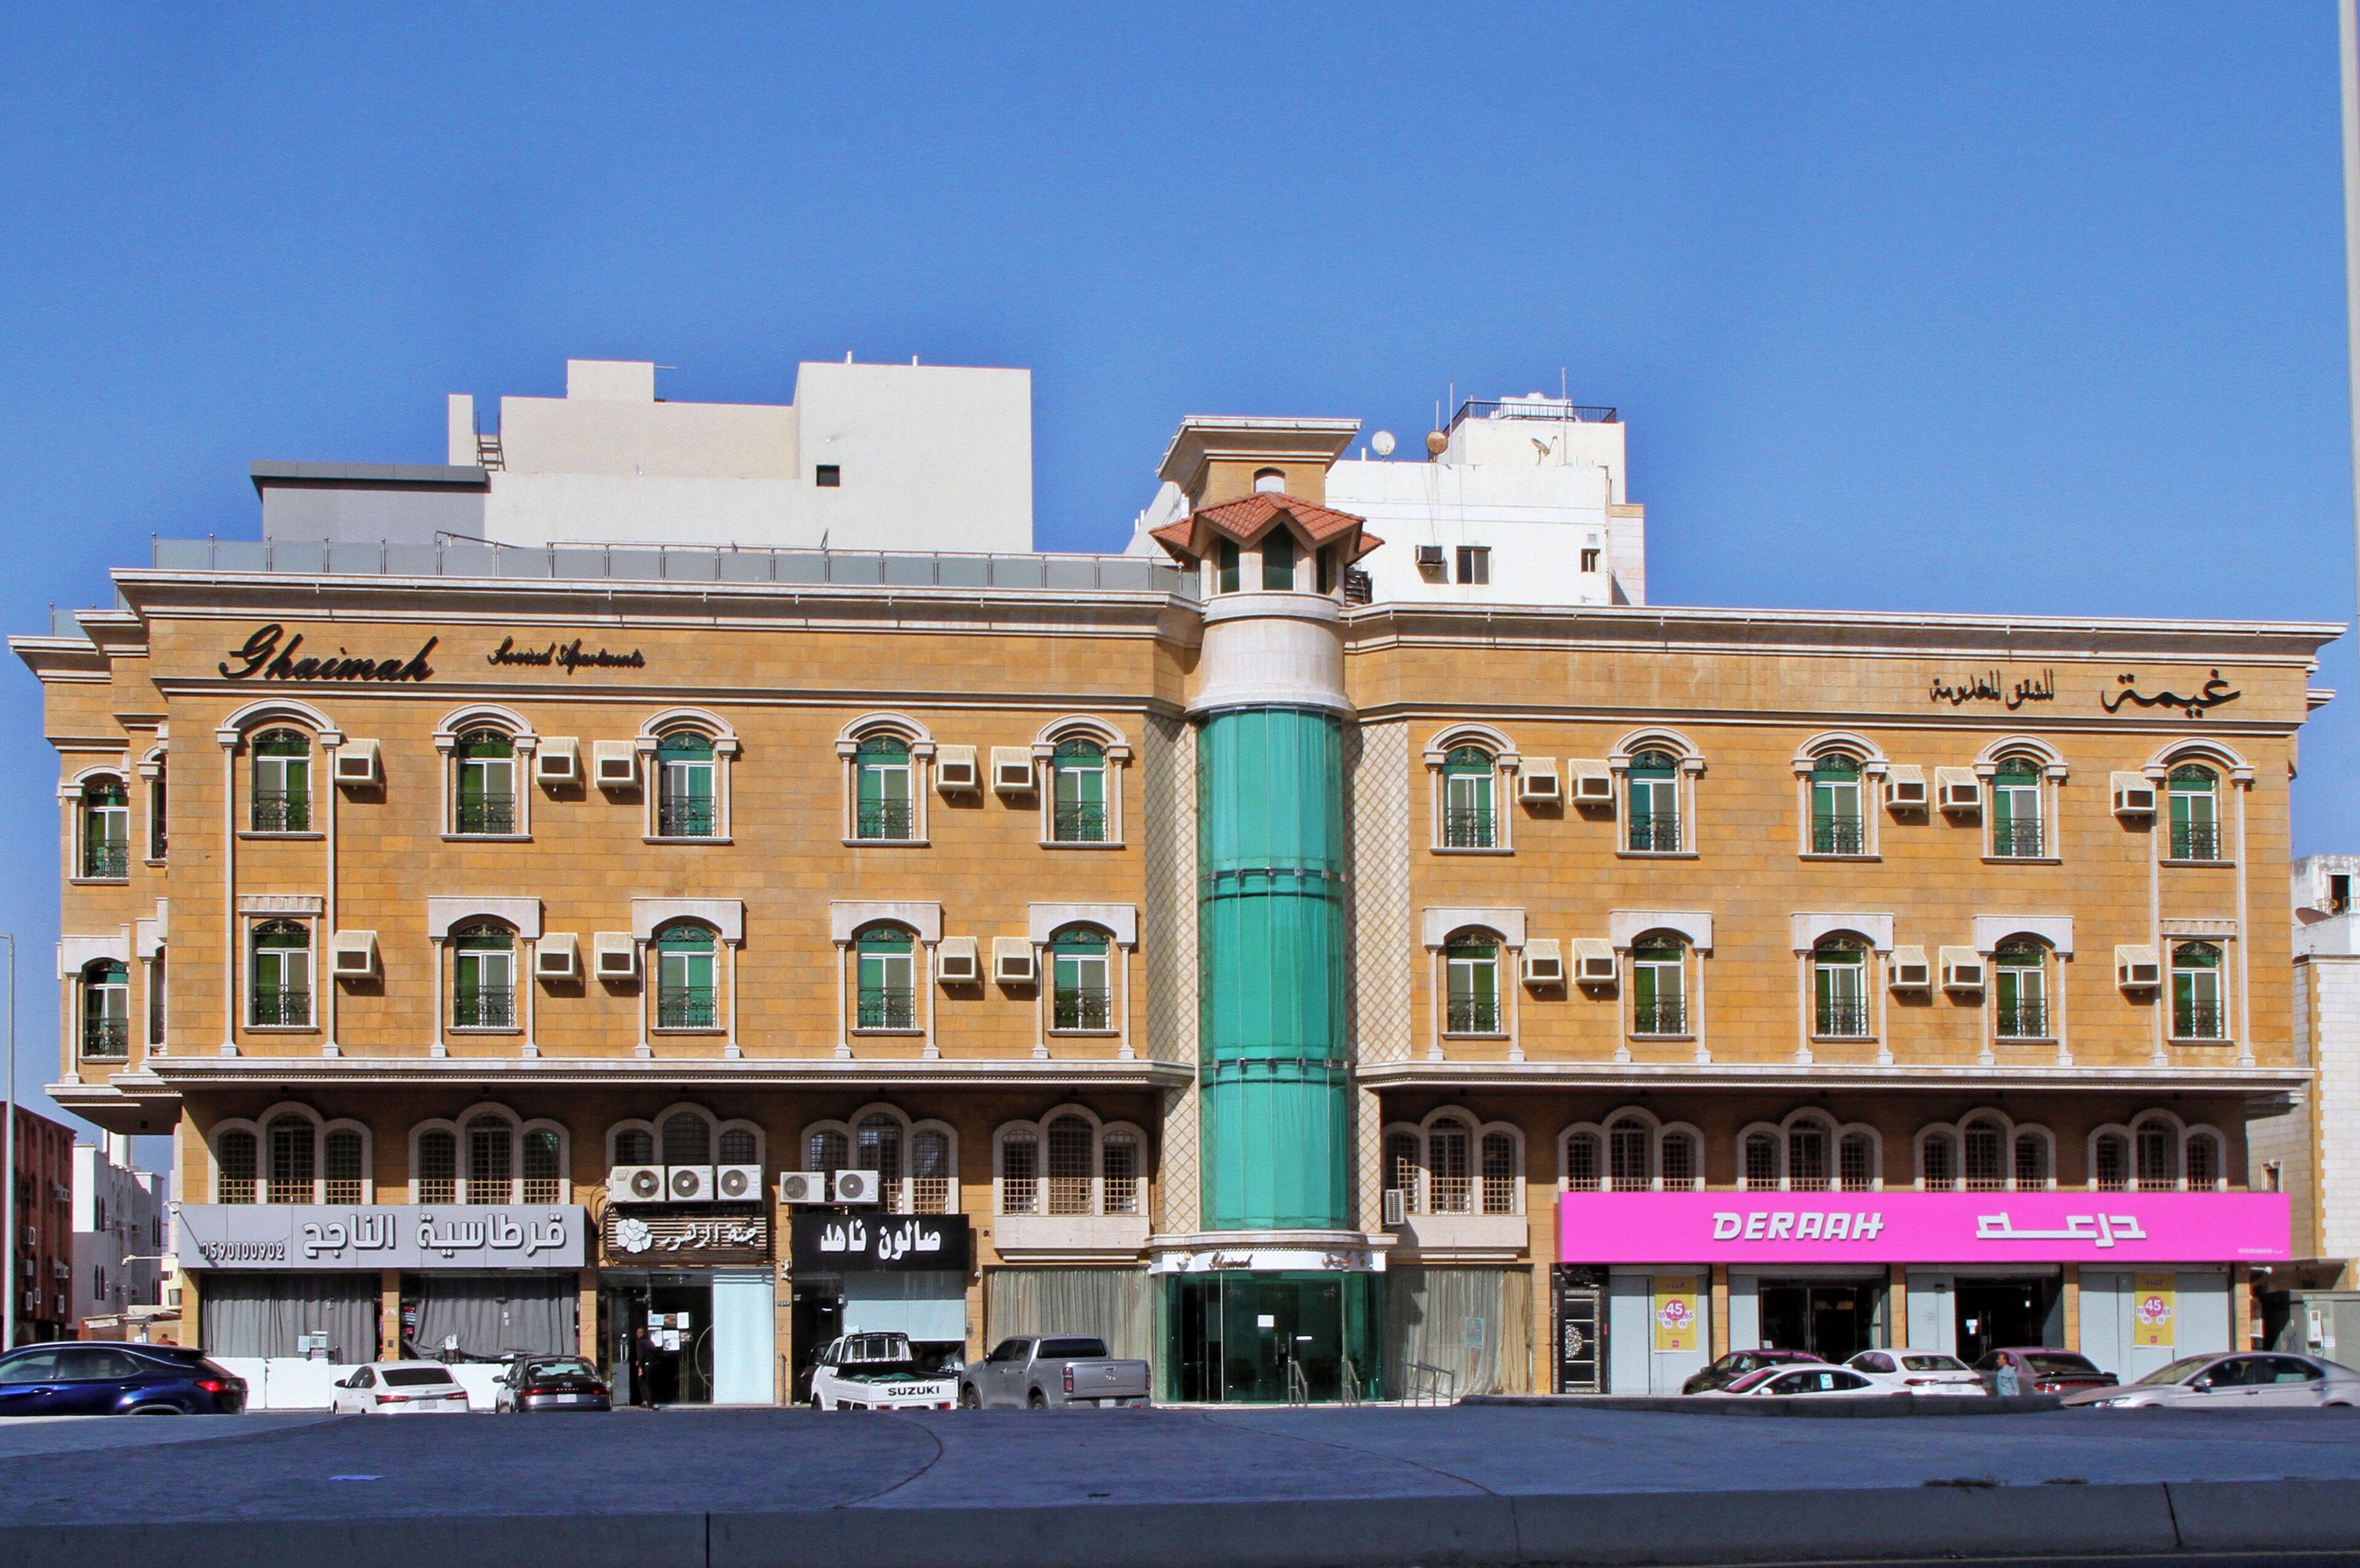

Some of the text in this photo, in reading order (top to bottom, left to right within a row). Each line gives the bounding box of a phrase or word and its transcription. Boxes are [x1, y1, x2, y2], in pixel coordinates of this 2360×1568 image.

[219, 624, 438, 681] Ghaimah
[487, 636, 645, 676] Serviced Apartments
[2101, 668, 2241, 719] غيمة
[302, 1213, 566, 1260] قرطاسية الناجح
[658, 1223, 757, 1252] جنة الزهور
[820, 1218, 941, 1260] صالون ناهد
[1712, 1212, 1884, 1241] DERAAH
[1666, 1303, 1683, 1315] 45
[2145, 1299, 2161, 1311] 45
[887, 1386, 940, 1397] SUZUKI
